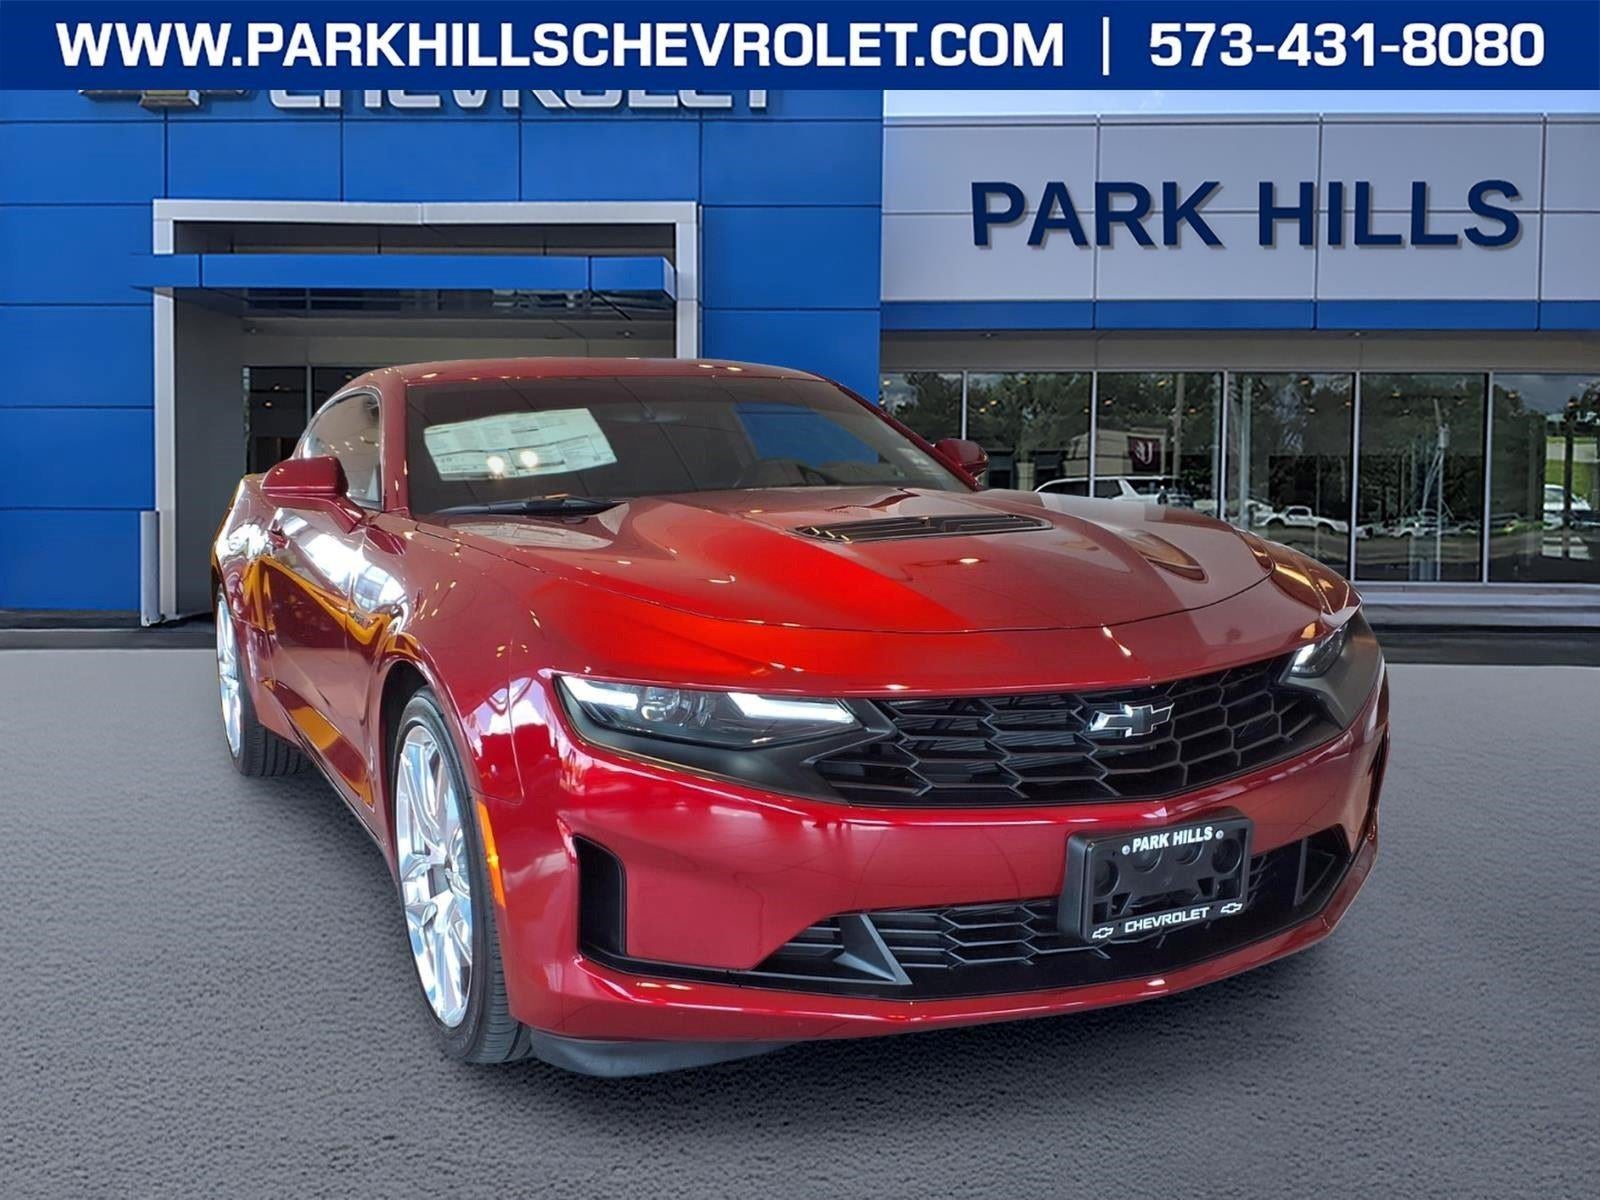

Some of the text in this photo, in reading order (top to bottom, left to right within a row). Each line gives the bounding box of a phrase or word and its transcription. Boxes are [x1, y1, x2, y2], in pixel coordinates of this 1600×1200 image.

[971, 179, 1523, 248] PARK HILLS
[1132, 826, 1213, 853] PARK HILLS
[1124, 907, 1210, 933] CHEVROLET
